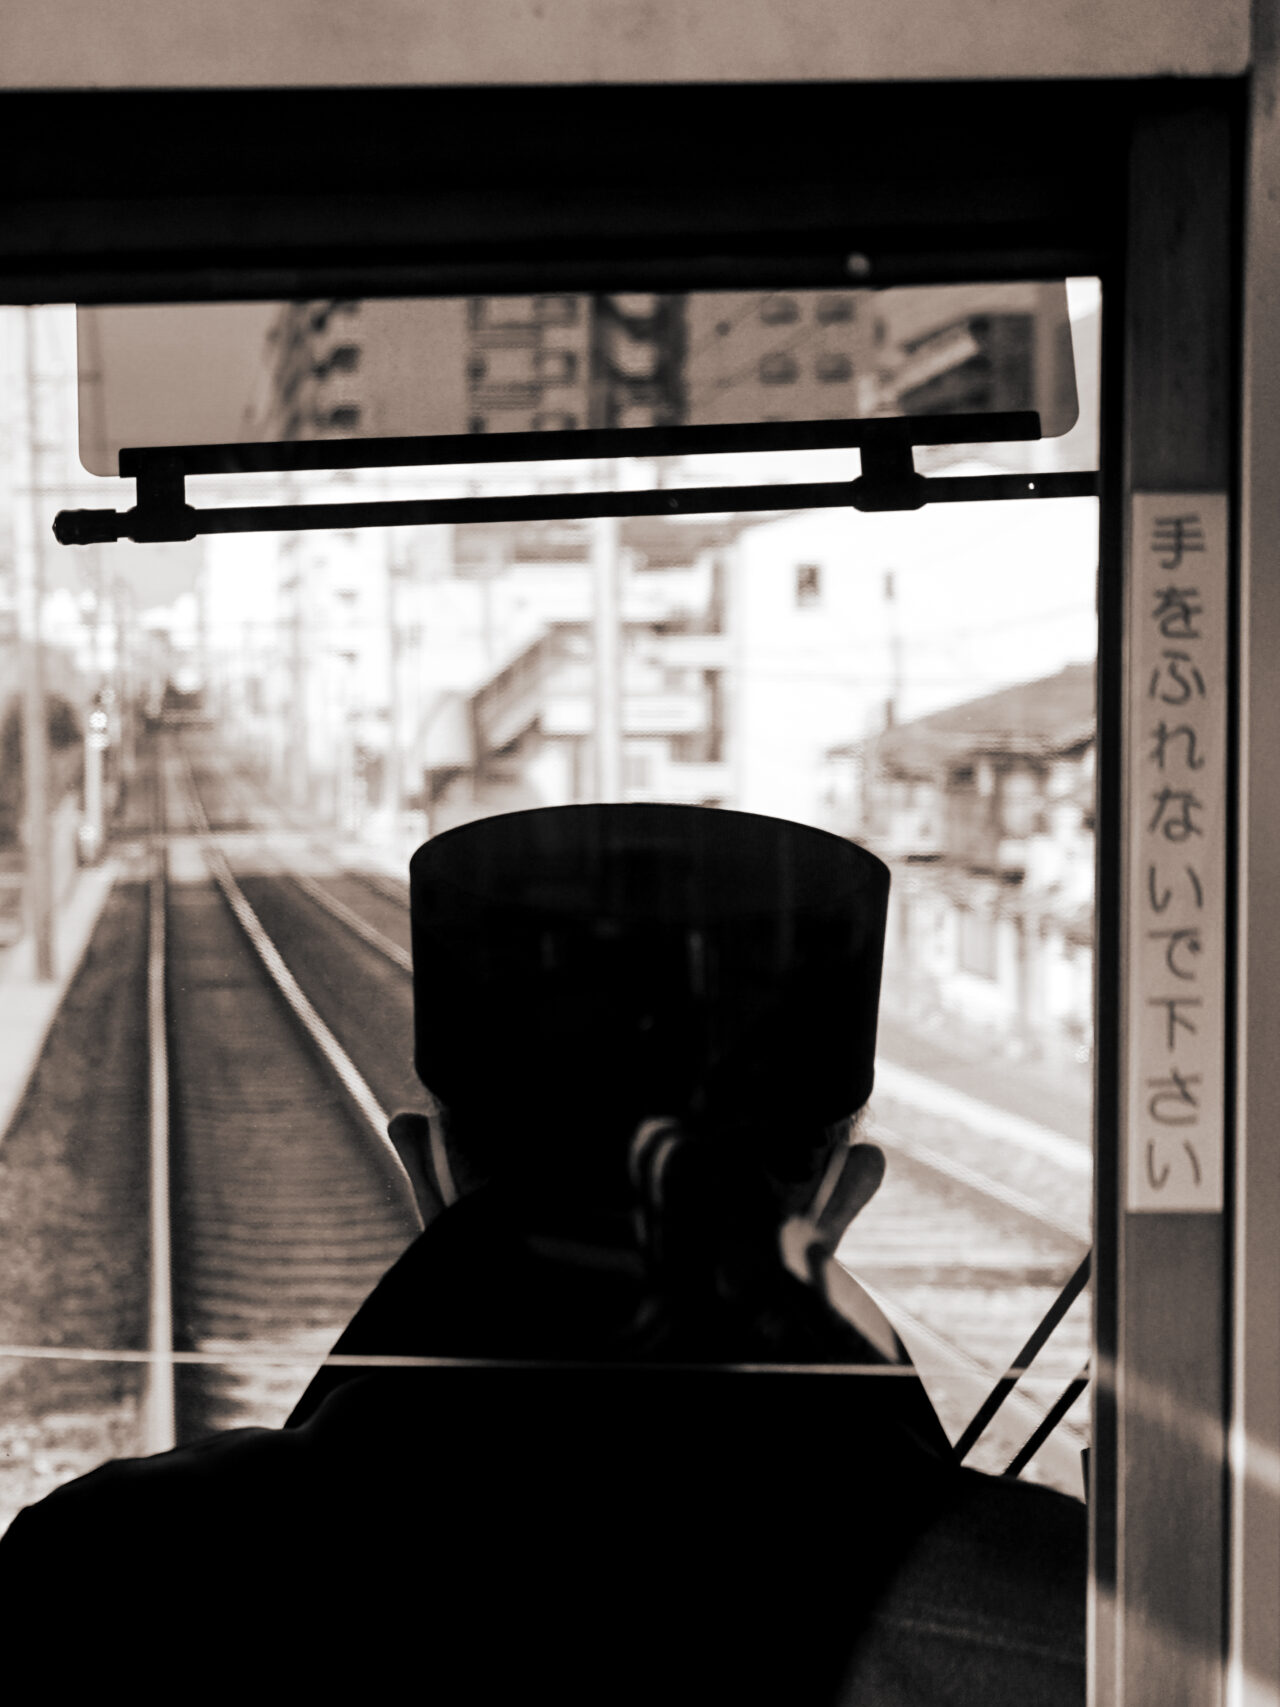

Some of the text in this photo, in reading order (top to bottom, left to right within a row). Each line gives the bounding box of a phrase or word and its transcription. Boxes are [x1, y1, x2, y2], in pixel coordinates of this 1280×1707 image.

[1147, 515, 1205, 1191] 手をふれないで下さい
